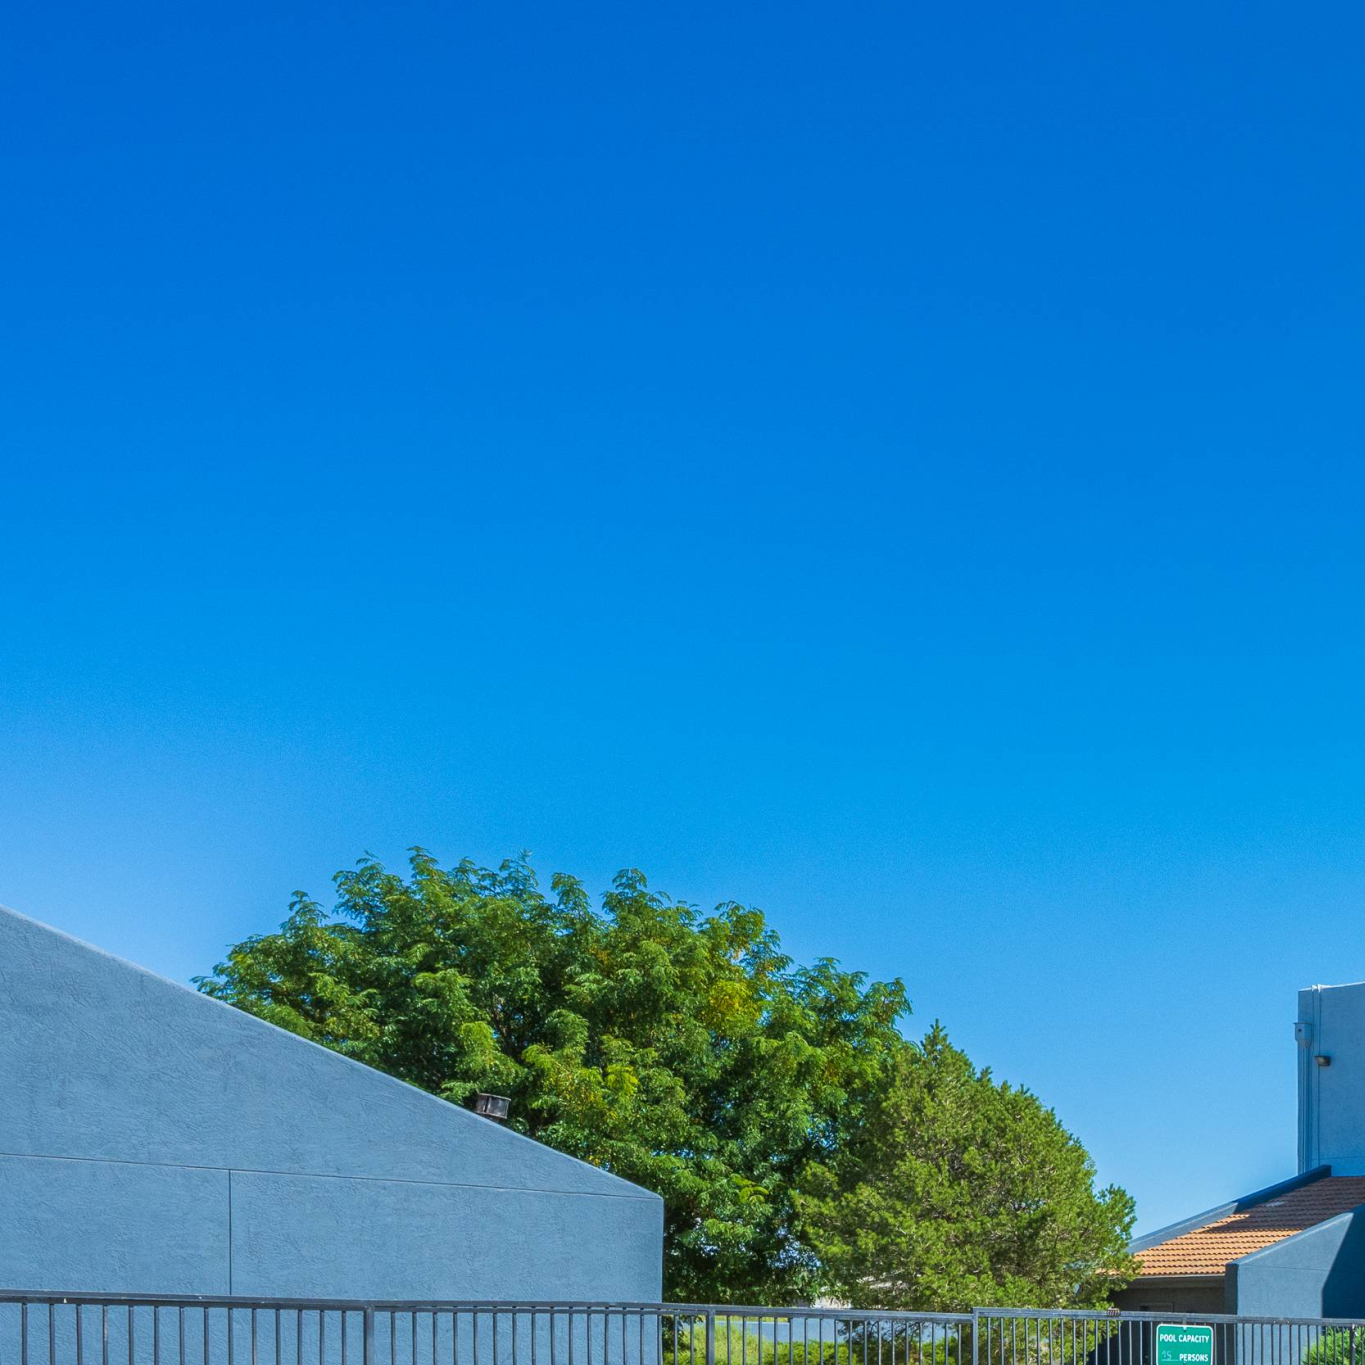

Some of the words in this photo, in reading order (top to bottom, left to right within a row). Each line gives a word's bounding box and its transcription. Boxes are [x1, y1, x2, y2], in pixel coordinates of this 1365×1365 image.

[1159, 1334, 1177, 1342] POOL
[1178, 1334, 1210, 1343] CAPACITY
[1179, 1353, 1209, 1362] PERSONS
